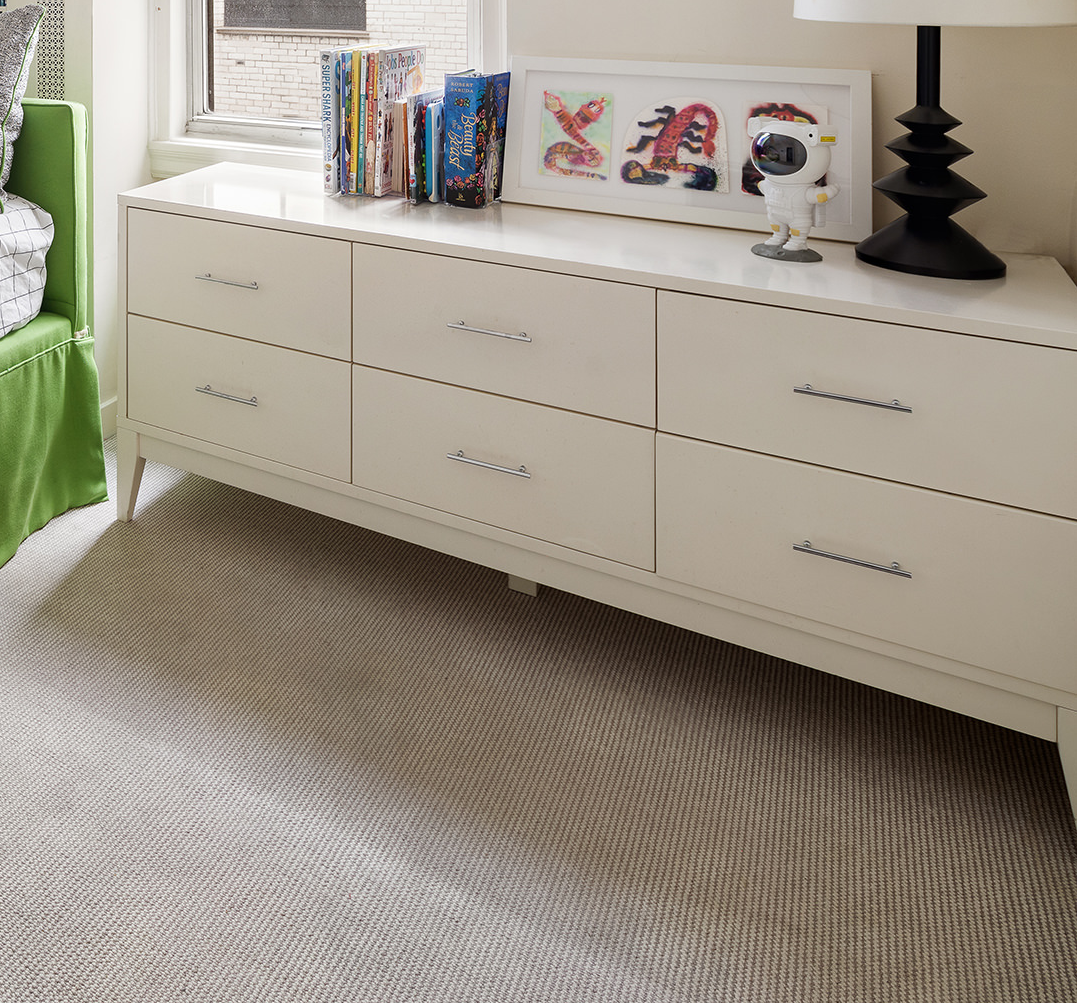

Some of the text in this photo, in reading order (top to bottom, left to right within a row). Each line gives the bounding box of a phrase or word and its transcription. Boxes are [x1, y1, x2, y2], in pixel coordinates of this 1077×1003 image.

[398, 51, 416, 71] People
[416, 50, 425, 65] Do
[321, 64, 331, 92] SUPER
[322, 93, 332, 122] SHARK
[459, 112, 477, 157] Beauty
[447, 129, 465, 171] Beast
